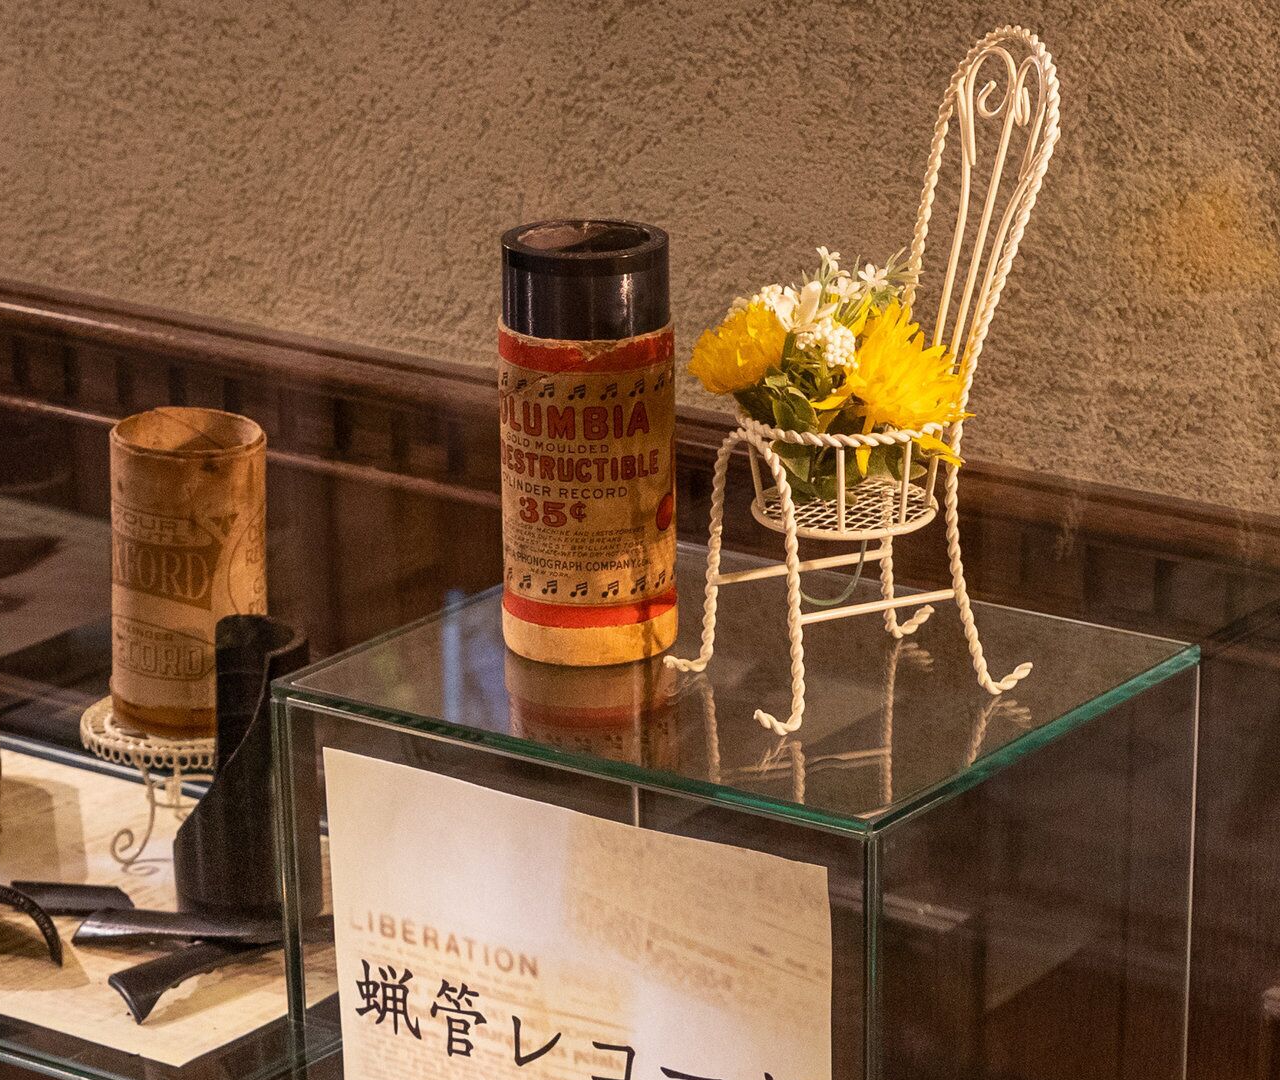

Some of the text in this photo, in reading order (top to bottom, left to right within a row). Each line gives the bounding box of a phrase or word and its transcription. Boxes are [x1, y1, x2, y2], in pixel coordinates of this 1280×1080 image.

[506, 431, 610, 455] GOLD MOULDED
[558, 486, 628, 500] RECORD
[519, 496, 588, 528] 35¢
[351, 906, 539, 979] LIBERATION
